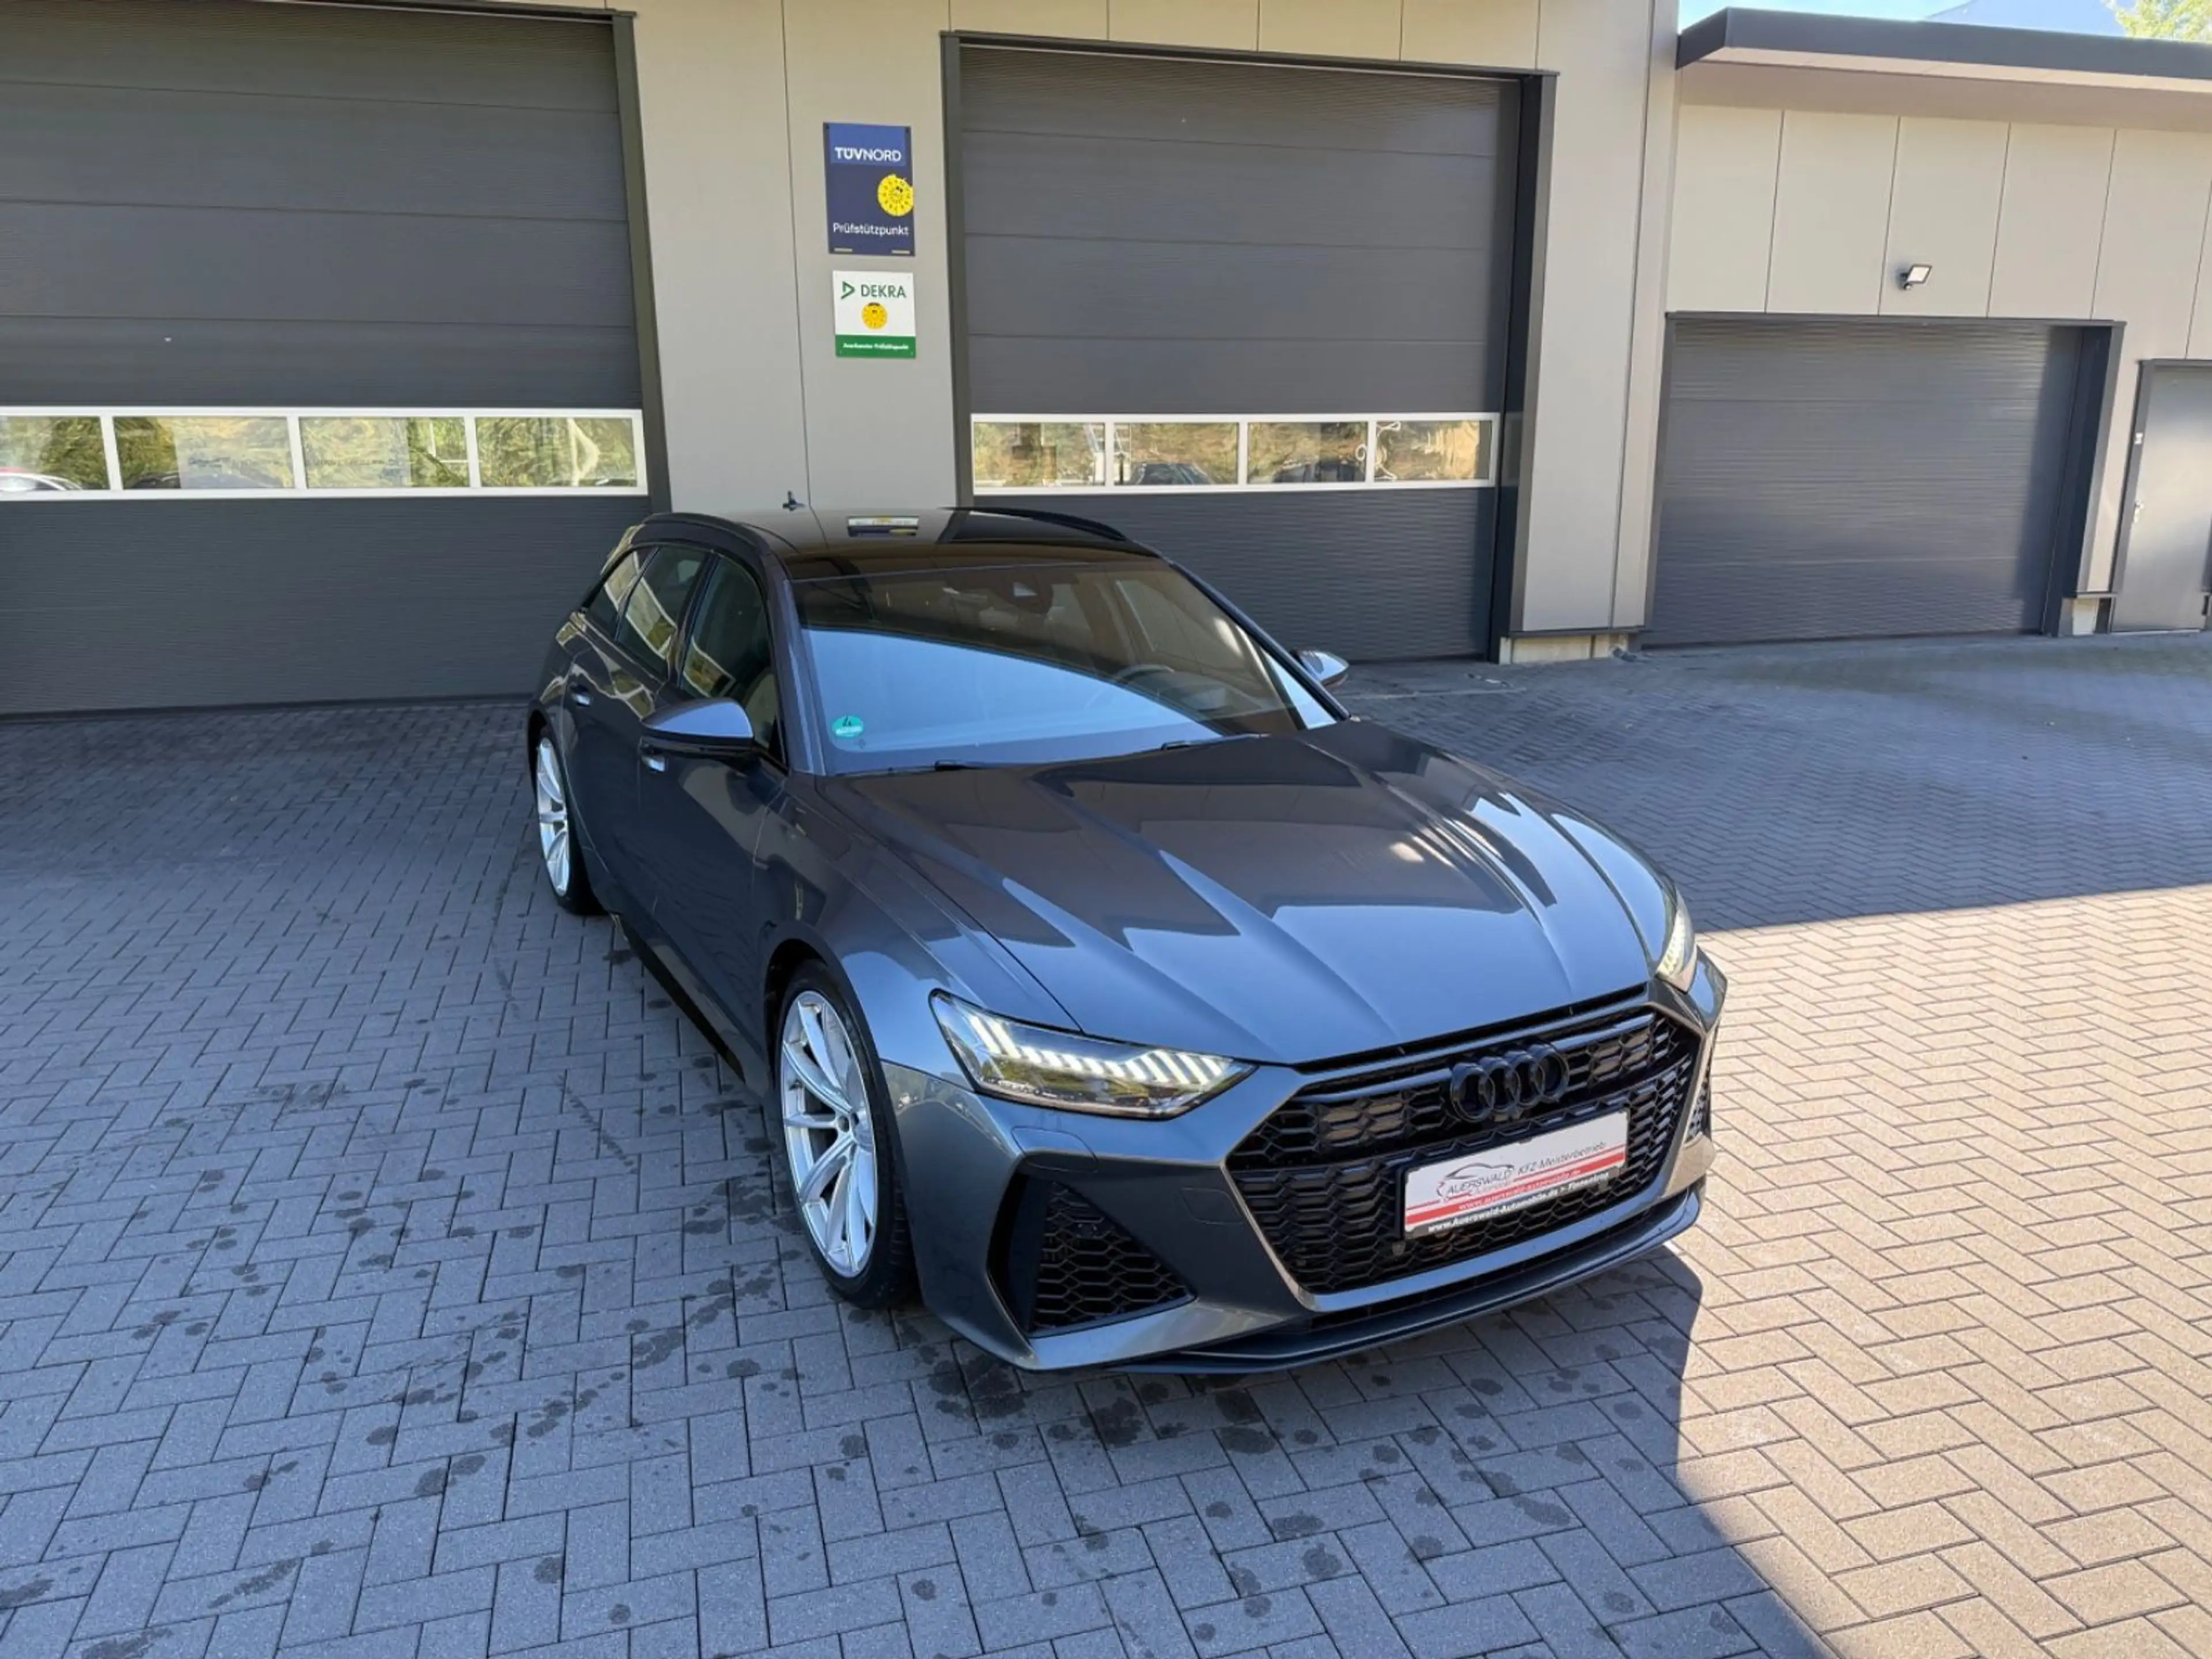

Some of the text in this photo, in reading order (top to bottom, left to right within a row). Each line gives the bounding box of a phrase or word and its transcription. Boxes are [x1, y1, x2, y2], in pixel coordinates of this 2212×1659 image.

[833, 222, 910, 237] Prüfstützpunkt
[861, 283, 907, 298] DEKRA
[1446, 1169, 1513, 1194] AUERSWALD
